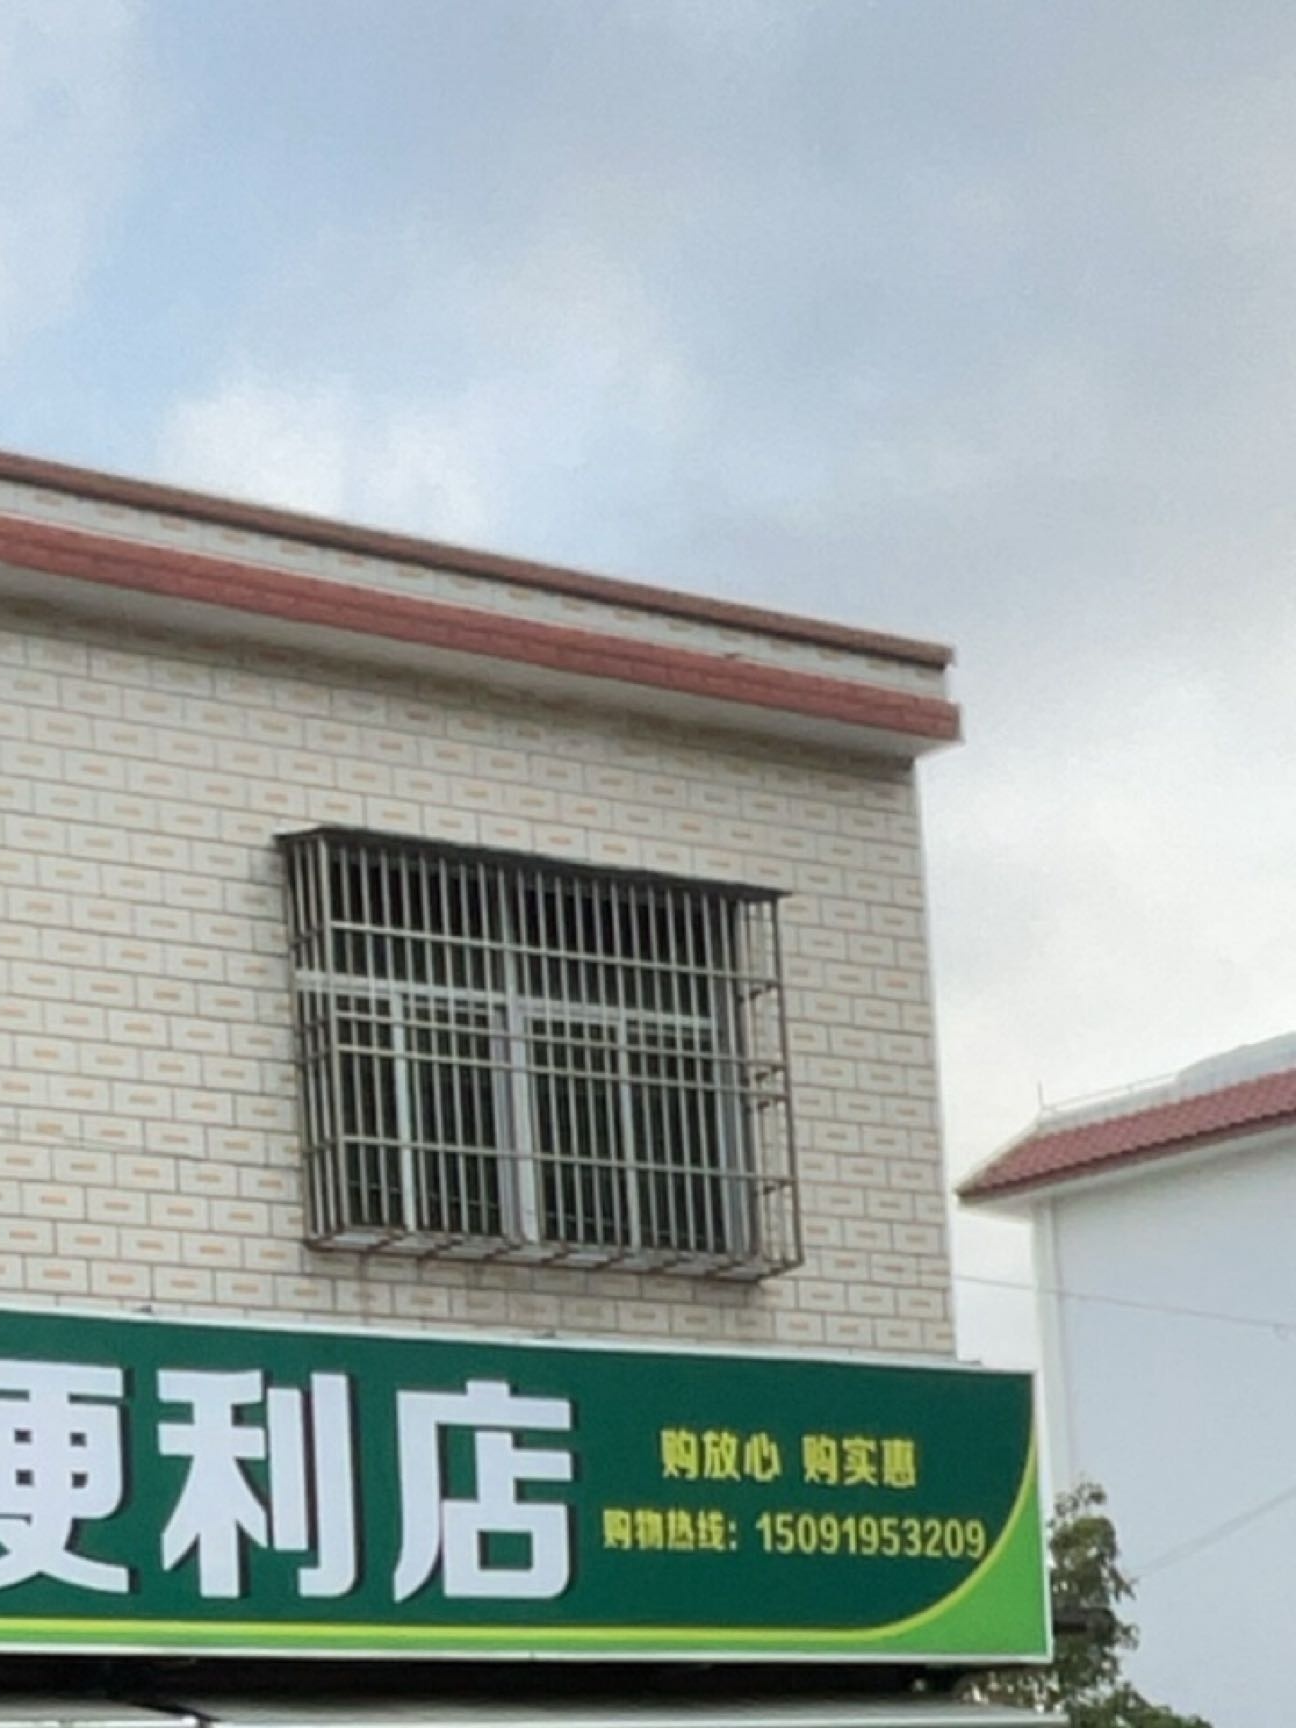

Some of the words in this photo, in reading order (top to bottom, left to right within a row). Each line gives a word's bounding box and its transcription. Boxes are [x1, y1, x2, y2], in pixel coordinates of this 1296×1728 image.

[660, 1427, 782, 1482] 购放心
[801, 1434, 917, 1488] 购实惠
[755, 1511, 986, 1559] 15091953209
